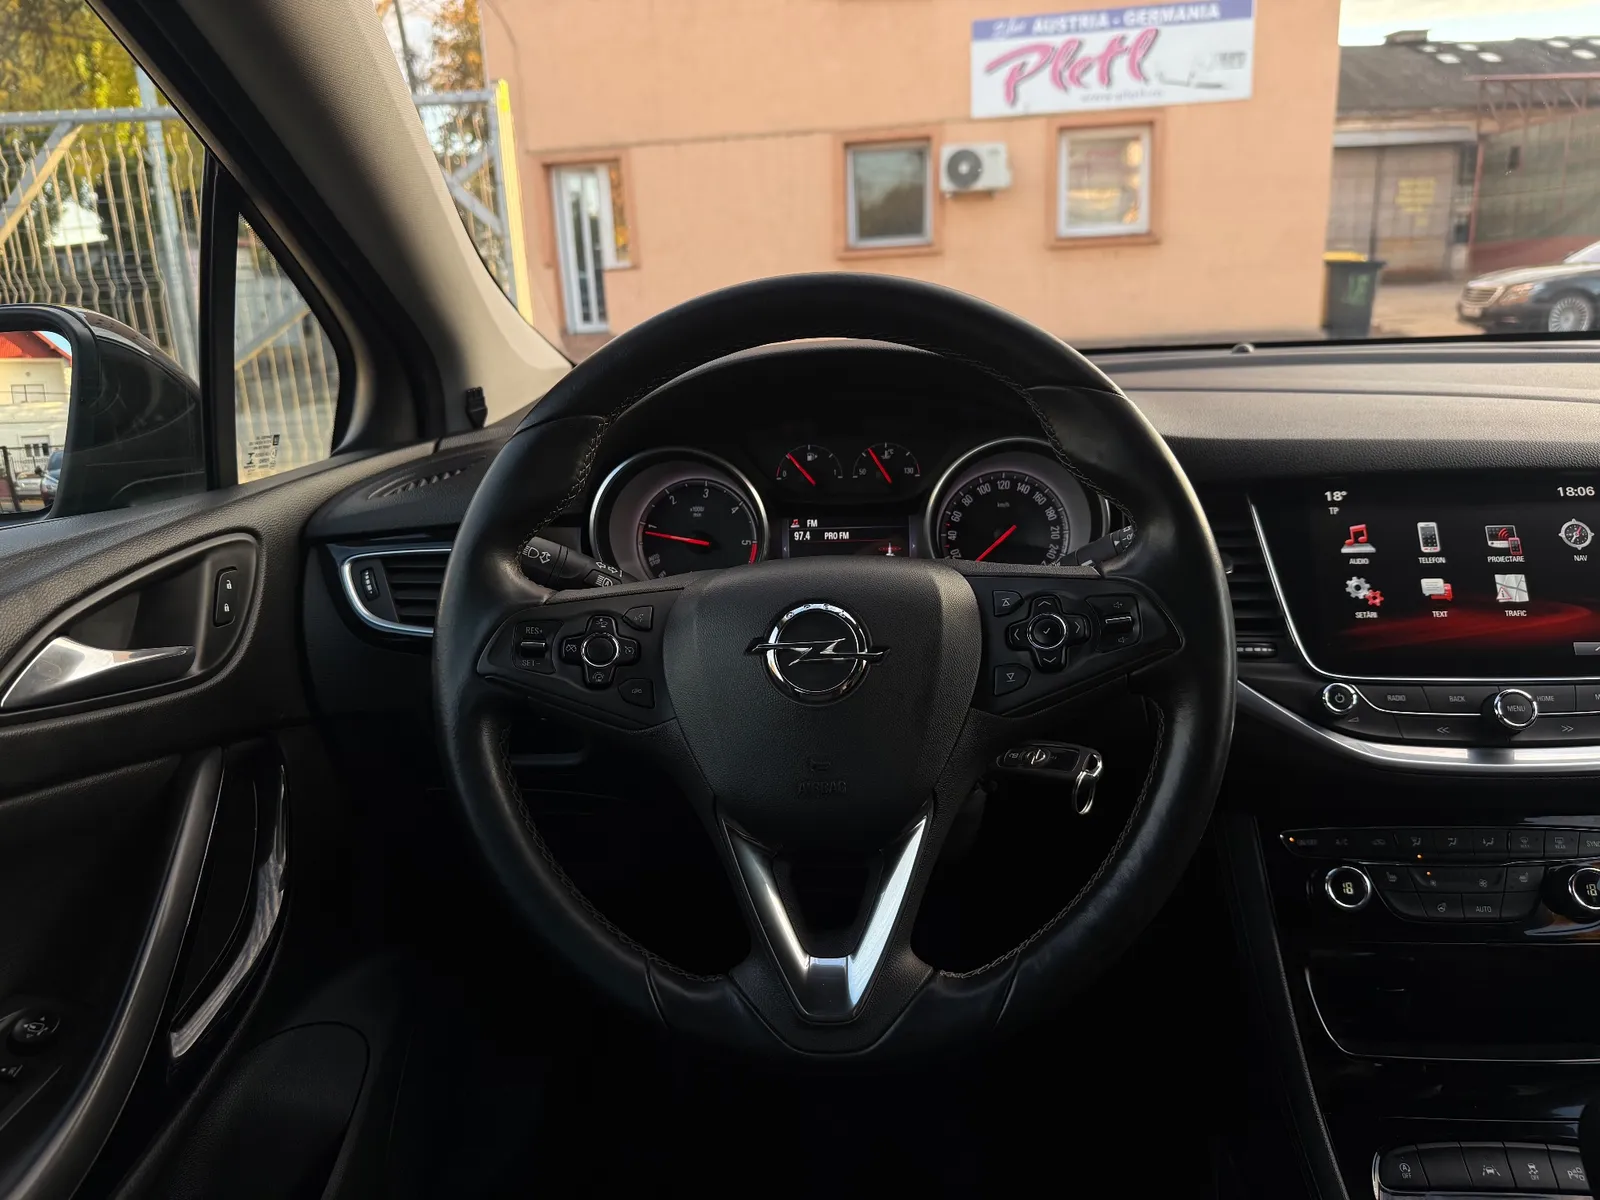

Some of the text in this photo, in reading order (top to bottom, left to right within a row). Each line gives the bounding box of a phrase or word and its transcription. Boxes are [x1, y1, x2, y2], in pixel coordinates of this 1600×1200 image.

[1032, 12, 1109, 35] AUSTRIA
[1124, 4, 1220, 26] GERMANIA
[977, 482, 991, 495] 100
[997, 480, 1010, 490] 120
[1016, 482, 1030, 494] 140
[702, 488, 709, 498] 3
[1324, 490, 1348, 501] 18°
[1557, 486, 1595, 497] 18:06
[669, 495, 677, 504] 2
[961, 494, 973, 506] 80
[1032, 491, 1046, 505] 160
[730, 506, 739, 514] 4
[1044, 506, 1056, 521] 180
[1328, 507, 1339, 515] TP
[951, 510, 962, 522] 60
[806, 519, 817, 527] FM
[794, 531, 849, 540] 97.4 PRO FM
[947, 530, 956, 541] 40
[1050, 525, 1060, 540] 210
[1046, 543, 1059, 559] 240
[1418, 556, 1446, 564] TELEFON
[1487, 555, 1525, 563] PROIECTARE
[1573, 554, 1587, 562] NAV
[1432, 610, 1448, 618] TEXT
[525, 626, 543, 634] RES+
[1343, 882, 1354, 894] 18
[1475, 905, 1492, 913] AUTO
